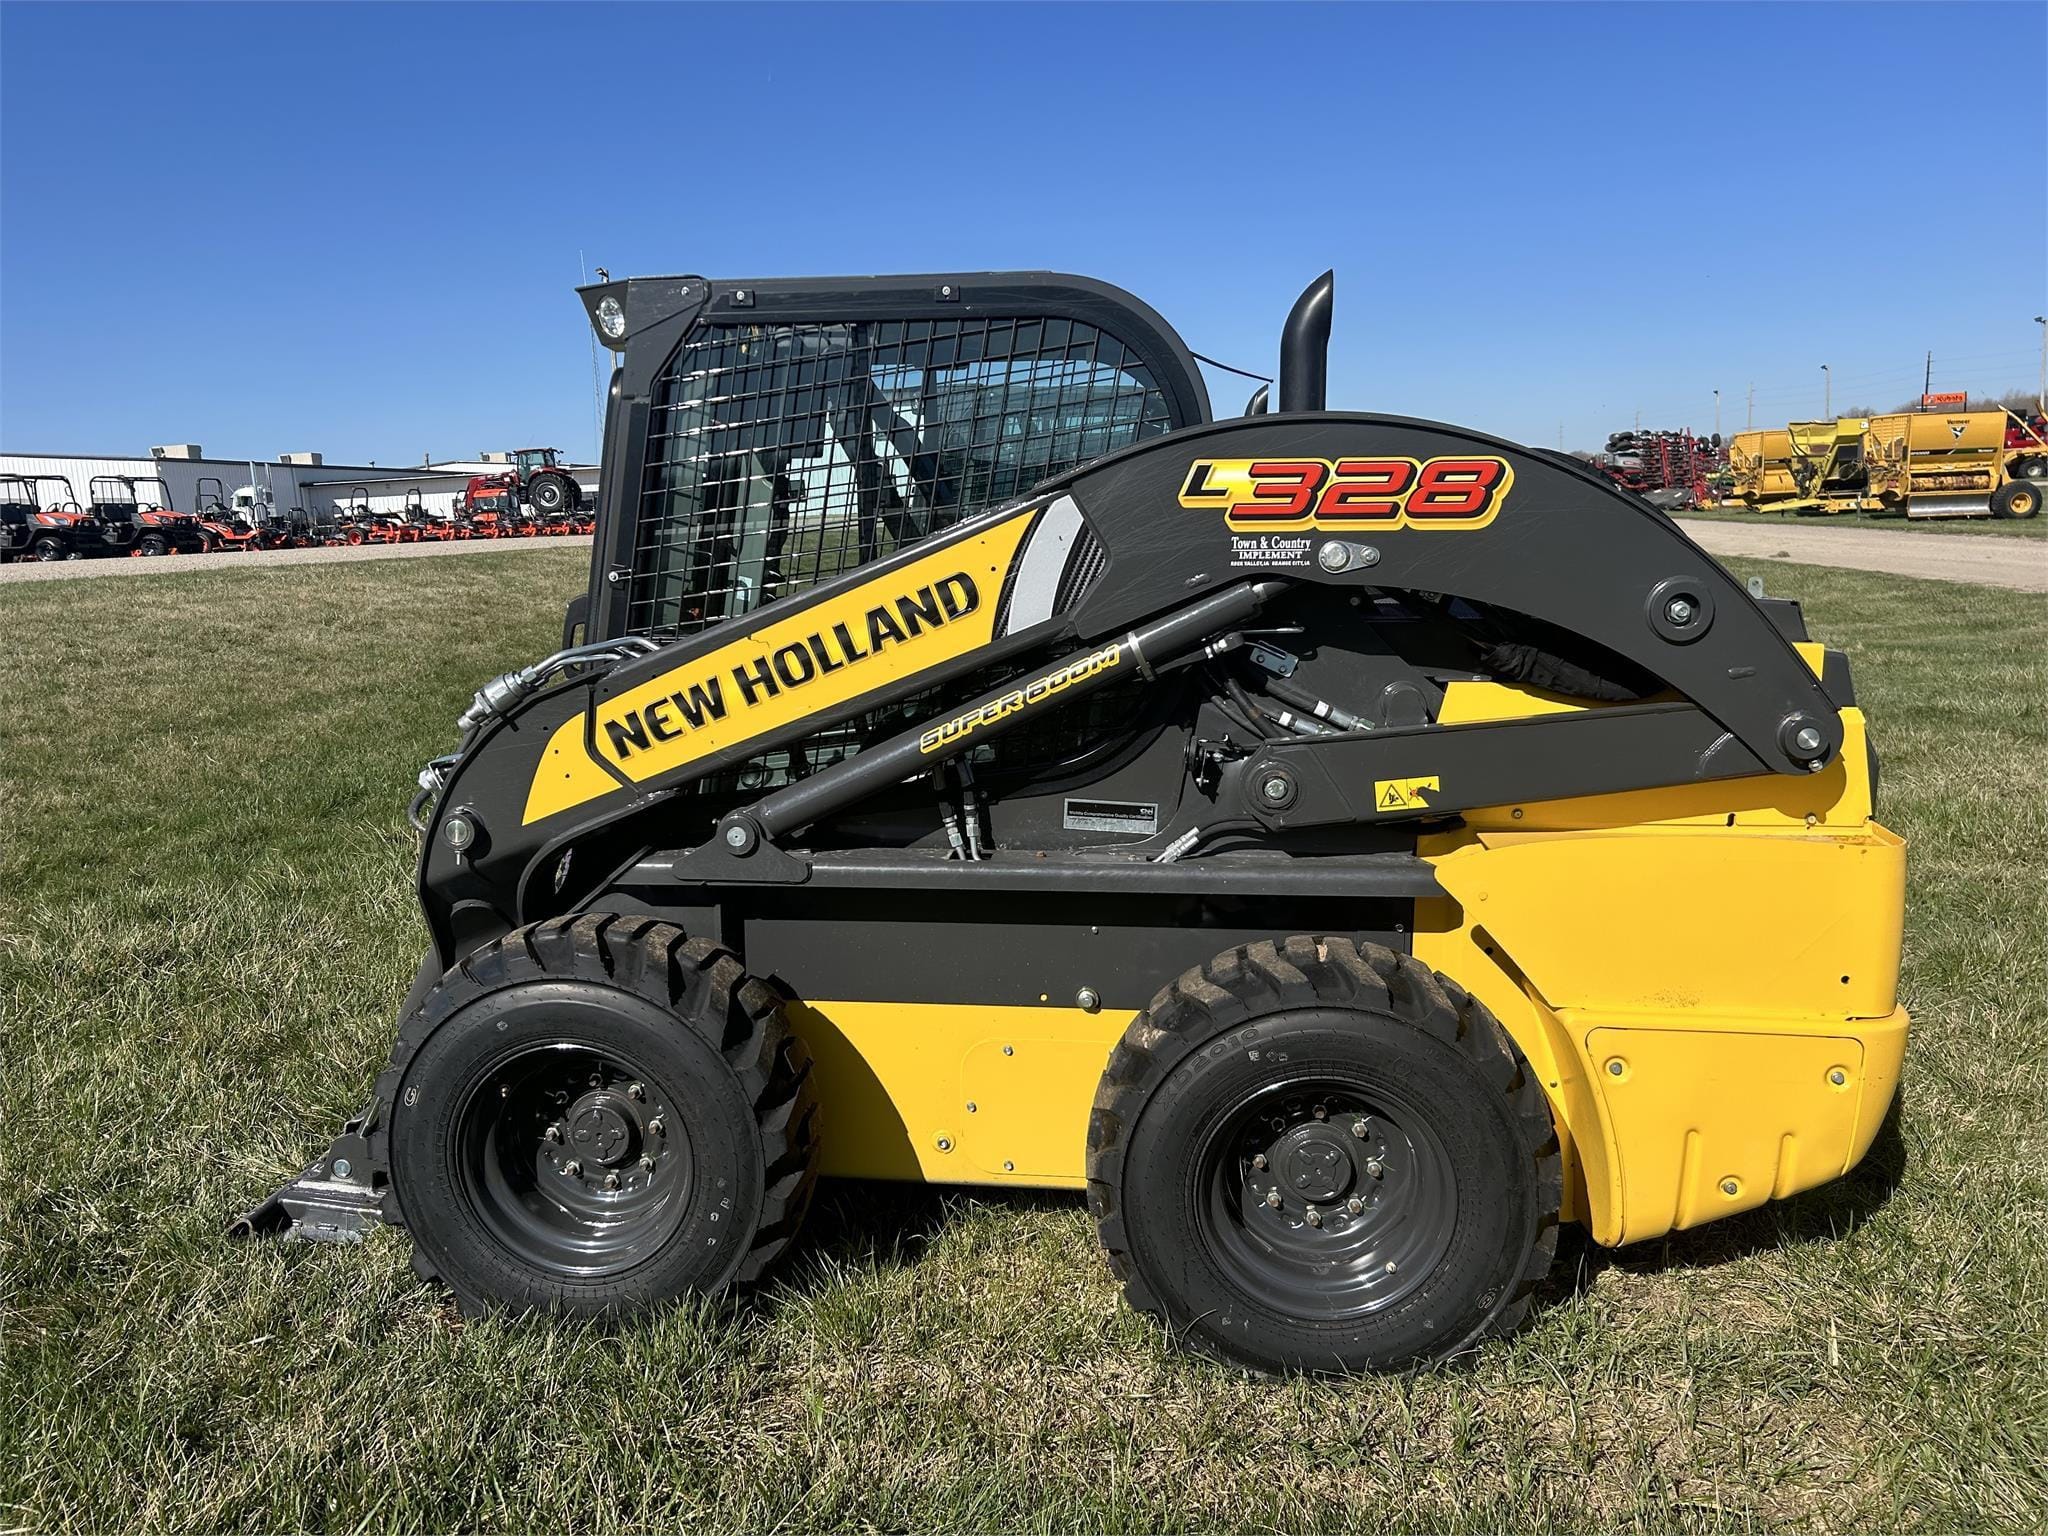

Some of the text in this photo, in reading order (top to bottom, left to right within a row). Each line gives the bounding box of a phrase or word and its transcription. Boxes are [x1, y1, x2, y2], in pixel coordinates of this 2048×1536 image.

[1937, 394, 1963, 402] Kubota
[1231, 536, 1311, 551] Town & Country
[1239, 551, 1303, 560] IMPLEMENT
[603, 571, 981, 760] NEW HOLLAND
[920, 644, 1120, 753] SUPER BOOM
[1155, 1028, 1260, 1113] XD2010
